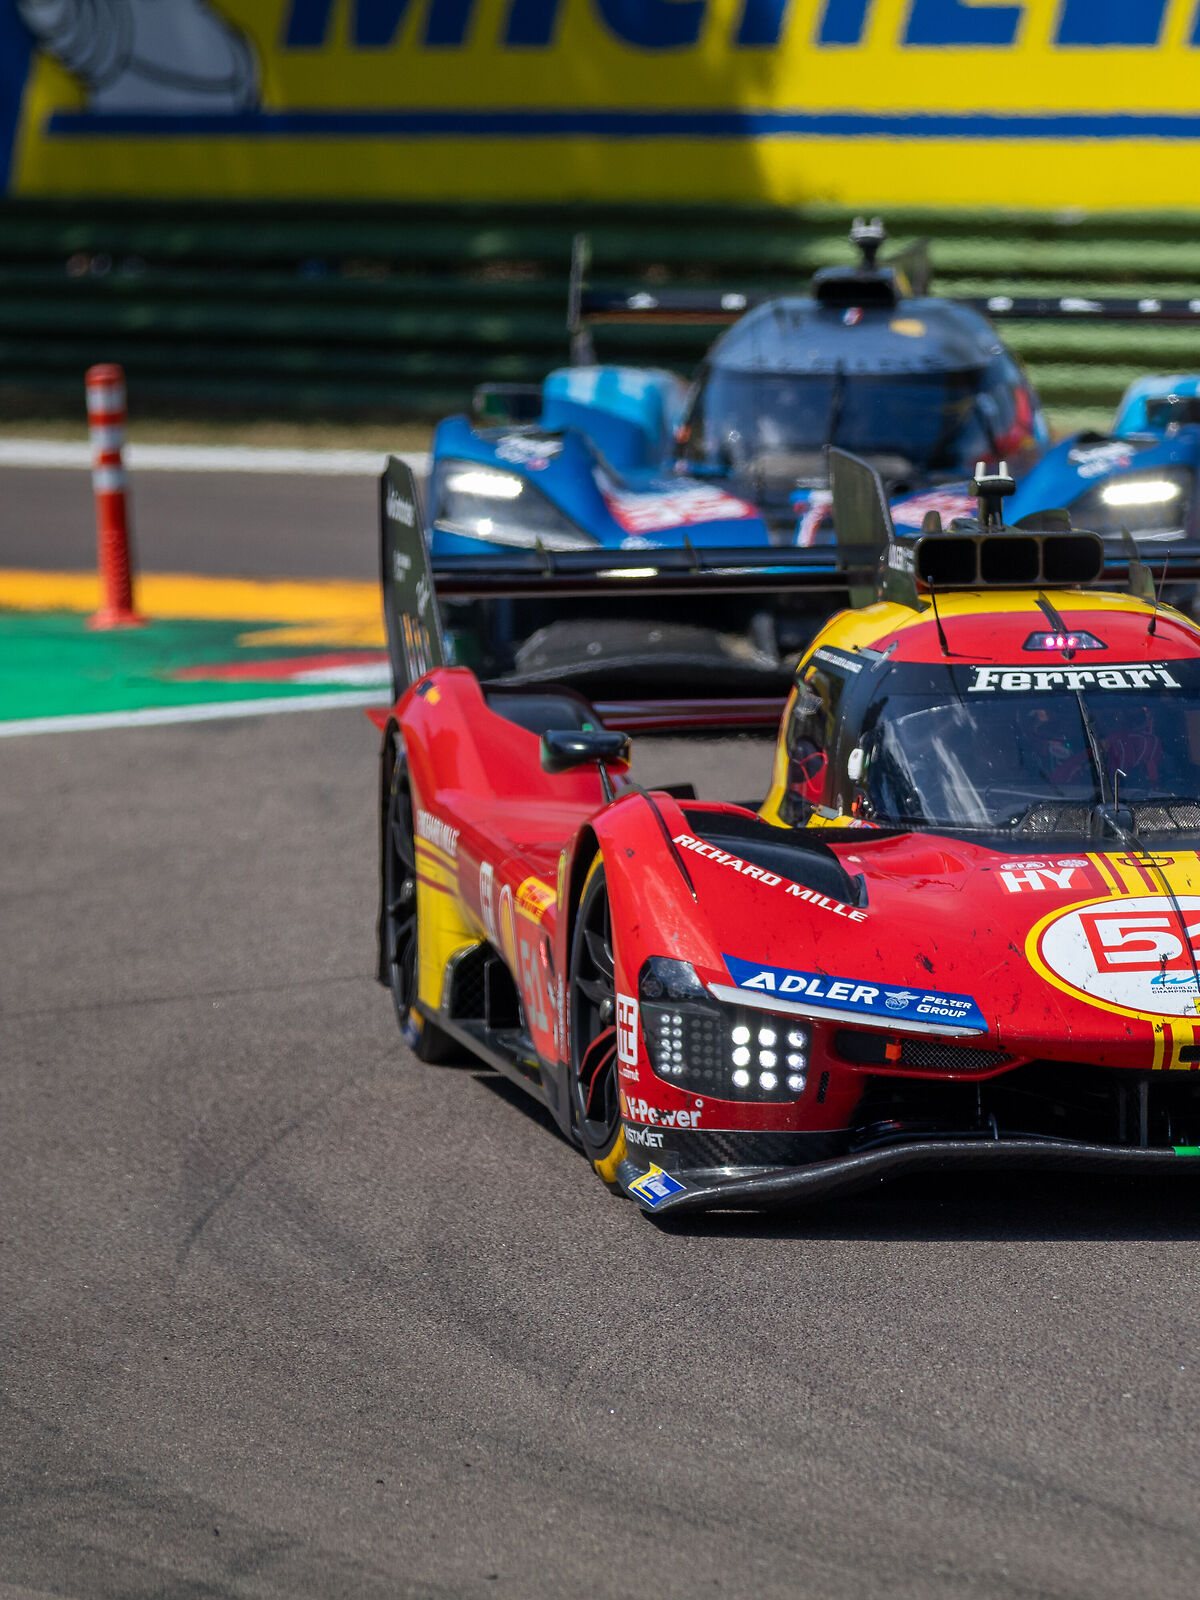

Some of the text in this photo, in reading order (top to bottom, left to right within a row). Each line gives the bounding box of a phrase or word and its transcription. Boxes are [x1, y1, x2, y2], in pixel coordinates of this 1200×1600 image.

[967, 664, 1182, 692] Ferrari
[672, 834, 869, 923] RICHARD MILLE
[1000, 868, 1075, 892] HY
[741, 971, 880, 1005] ADLER
[916, 1005, 967, 1018] GROUP
[921, 995, 972, 1010] PELZER
